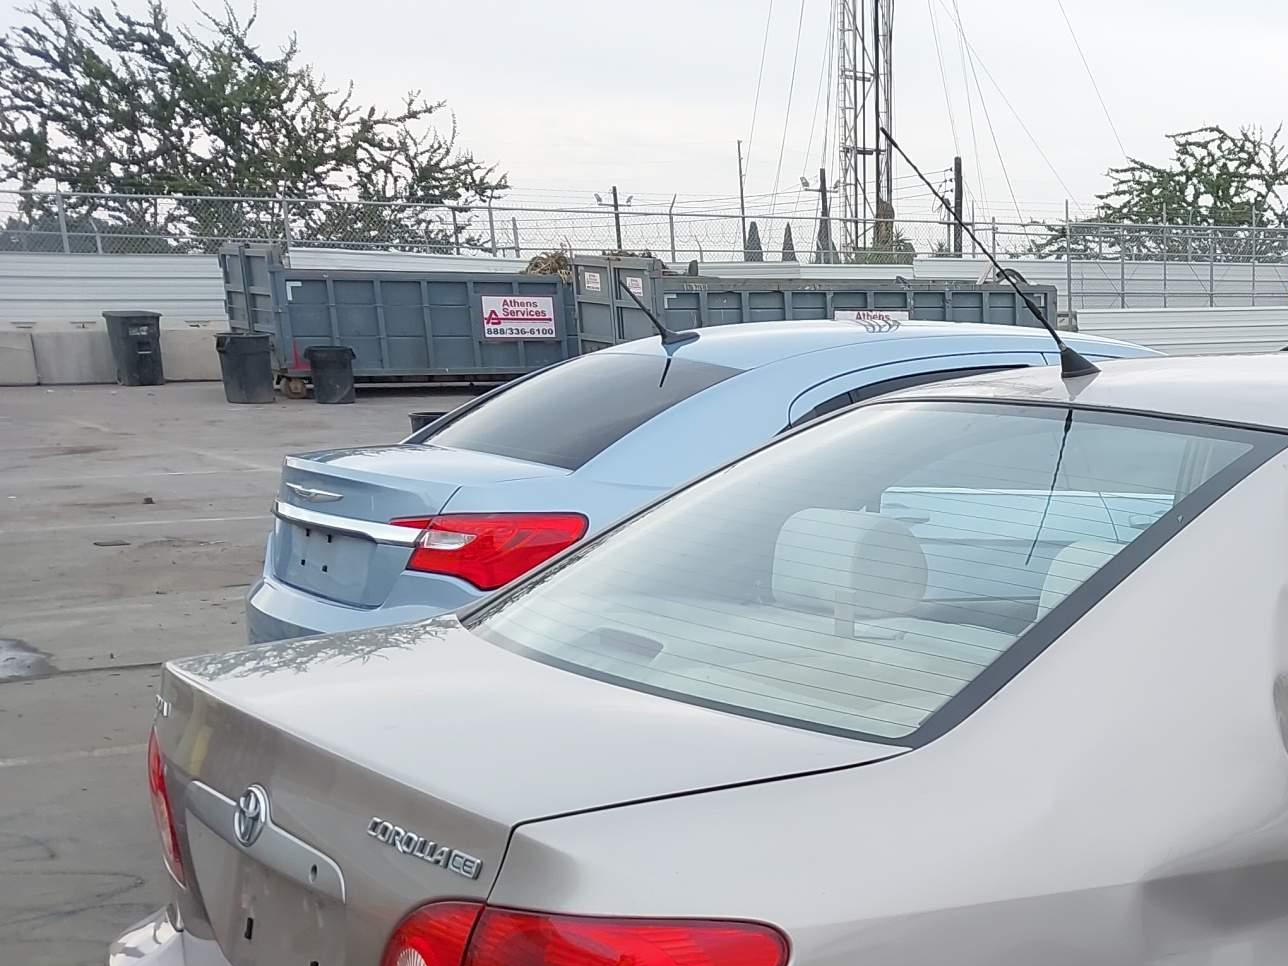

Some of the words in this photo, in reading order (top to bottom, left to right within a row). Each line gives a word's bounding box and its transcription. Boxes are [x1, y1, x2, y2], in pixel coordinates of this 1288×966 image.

[502, 299, 538, 308] Athens
[502, 308, 547, 317] Services
[855, 311, 891, 320] Athens
[486, 327, 554, 336] 888/336-6100
[367, 816, 450, 869] COROLLA
